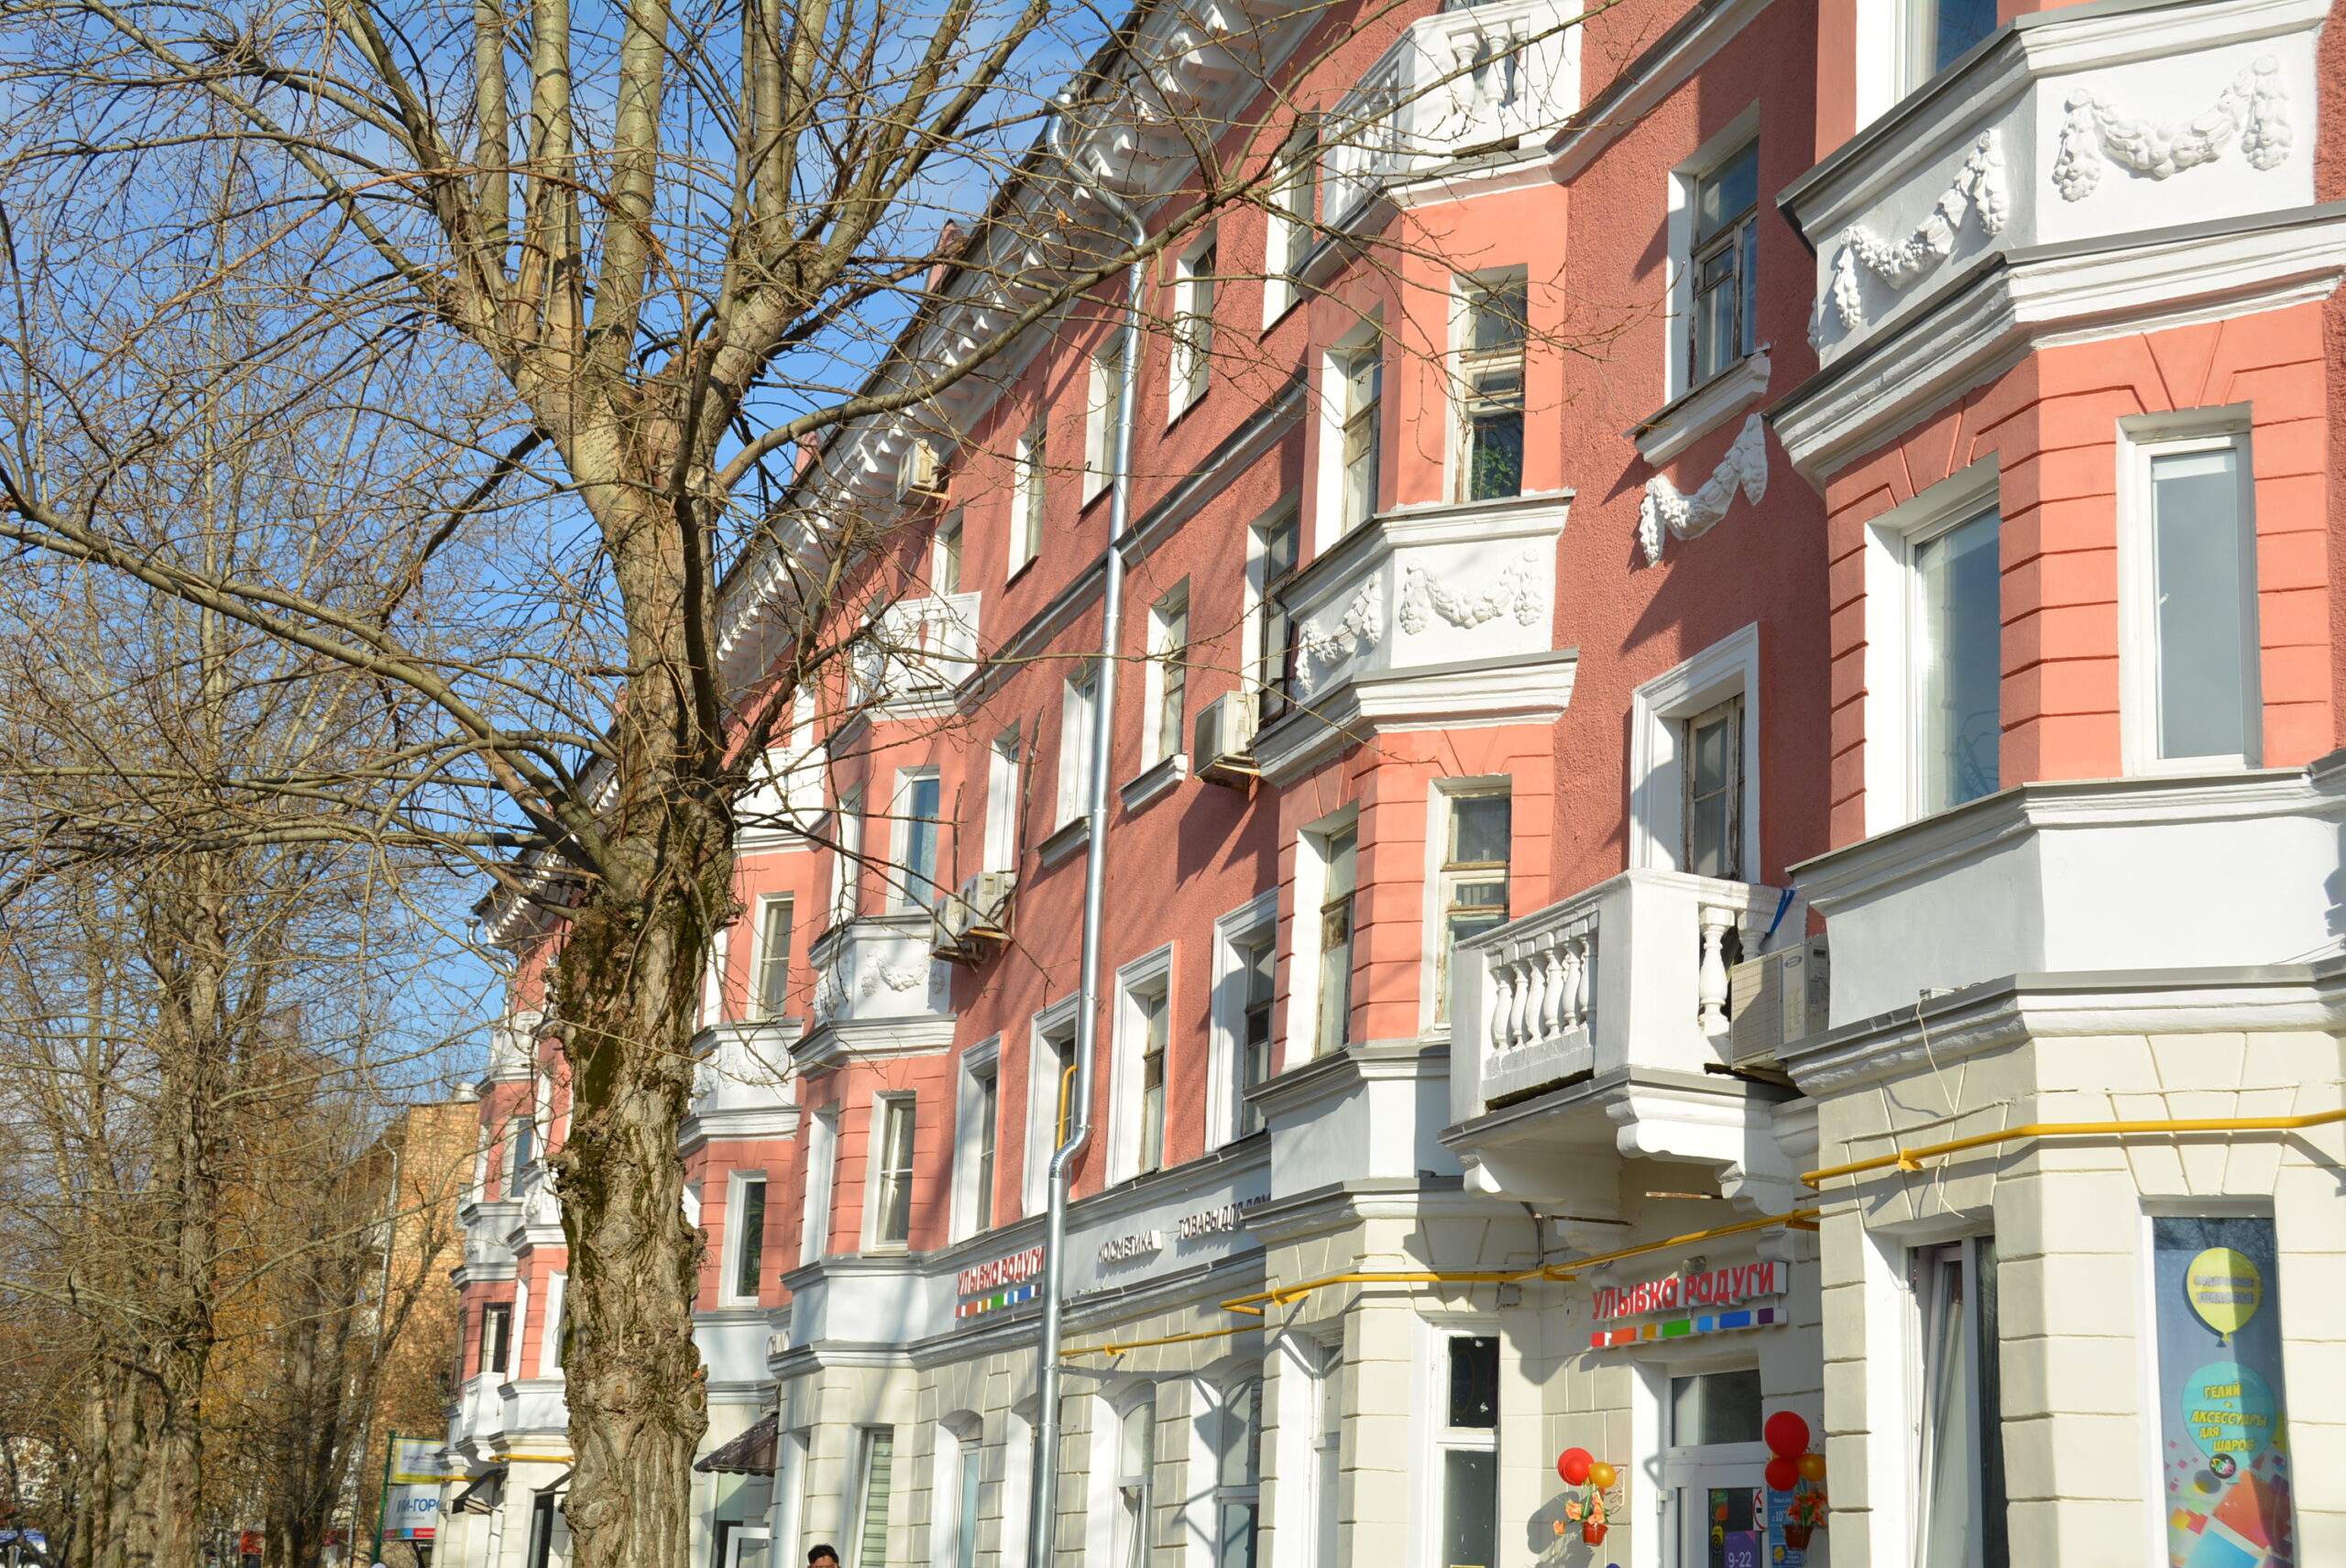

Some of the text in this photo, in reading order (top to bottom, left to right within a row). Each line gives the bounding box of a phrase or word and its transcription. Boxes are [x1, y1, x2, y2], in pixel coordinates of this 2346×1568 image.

[1178, 1206, 1221, 1239] ТОВАРЫ
[1098, 1230, 1154, 1264] КОСМЕТИКА
[2203, 1381, 2242, 1400] ГЕЛИЙ
[2190, 1409, 2270, 1428] АКСЕССУАРЫ
[2198, 1426, 2221, 1439] ДЛЯ
[2212, 1438, 2256, 1453] ШАРОВ
